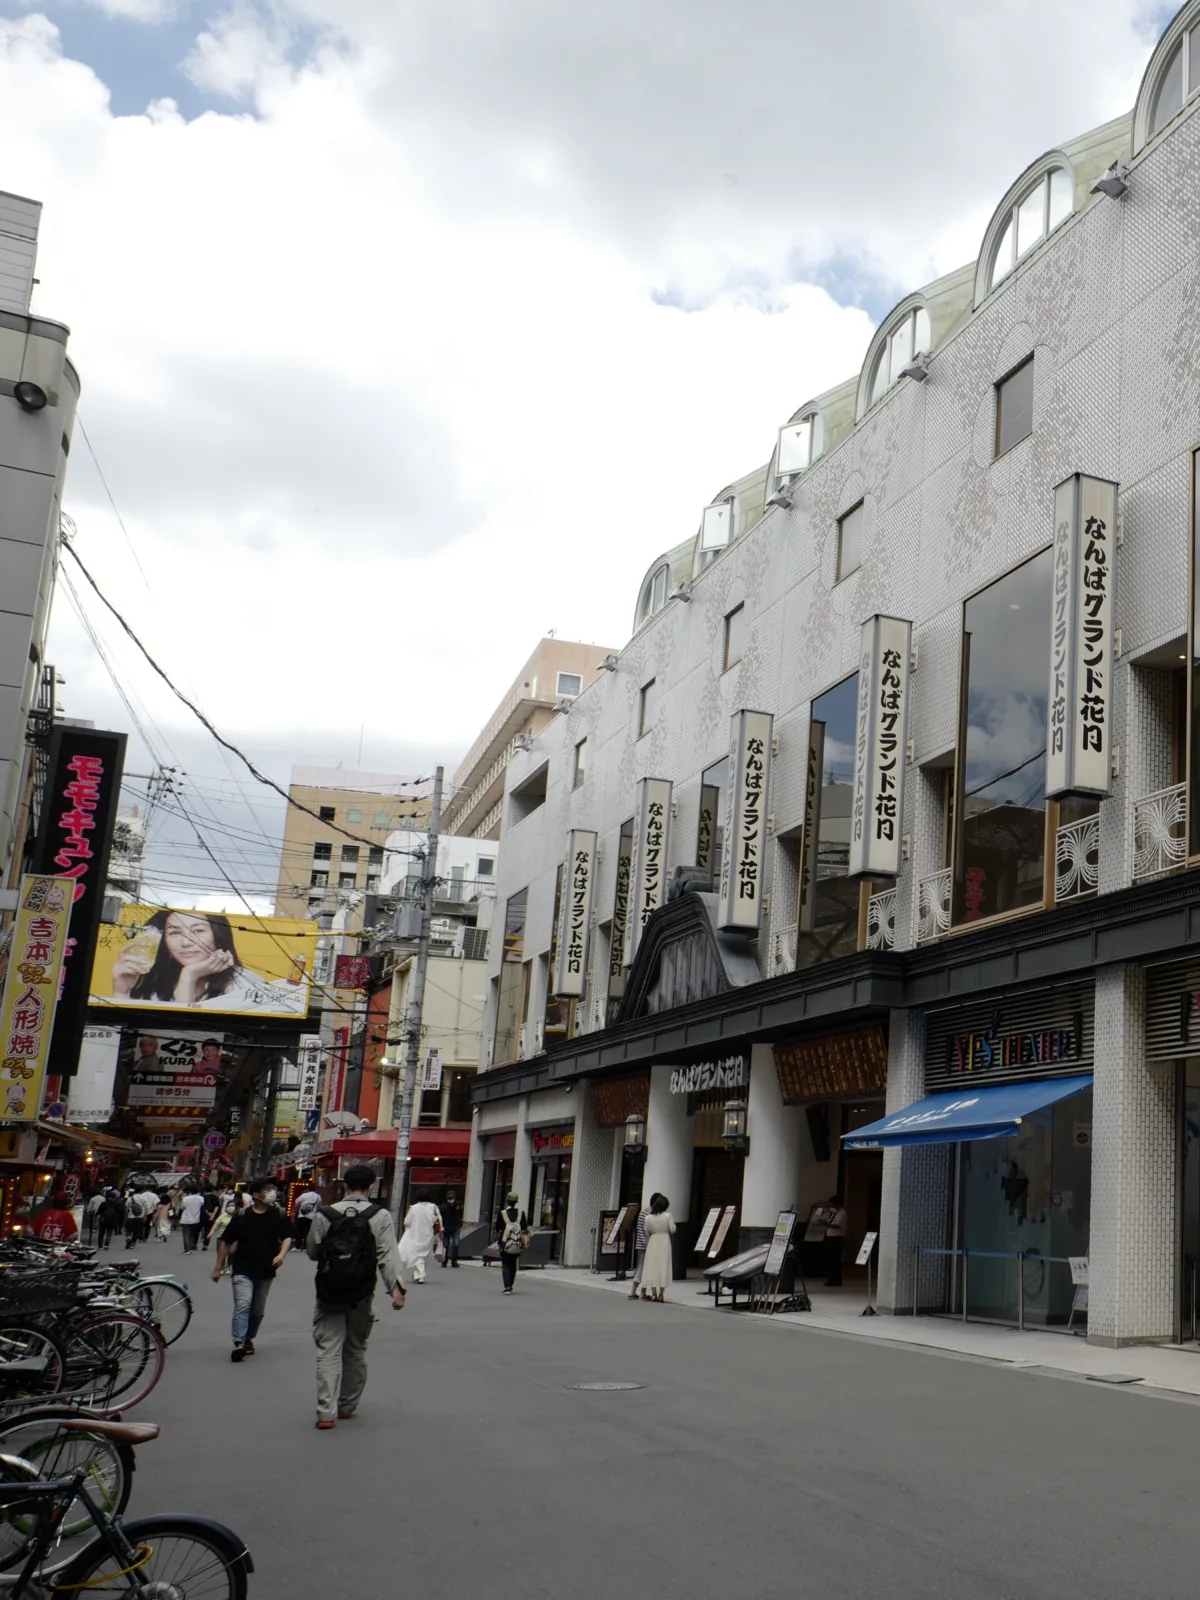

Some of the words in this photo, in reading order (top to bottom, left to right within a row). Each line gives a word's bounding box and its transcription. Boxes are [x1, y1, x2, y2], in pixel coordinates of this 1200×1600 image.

[1051, 520, 1070, 757] なんばグランド花月
[1080, 515, 1108, 753] なんばグランド花月
[875, 648, 902, 842] なんばグランド花月
[739, 737, 764, 900] なんばグランド花月
[26, 917, 54, 961] 吉本
[568, 851, 589, 974] なんばグランド花月
[10, 987, 41, 1055] 人形焼
[161, 1038, 197, 1057] くら
[159, 1057, 196, 1065] KURA
[303, 1054, 317, 1095] 磯丸水産
[669, 1055, 743, 1095] なんばグランド花月
[155, 1088, 191, 1096] 徒歩5分
